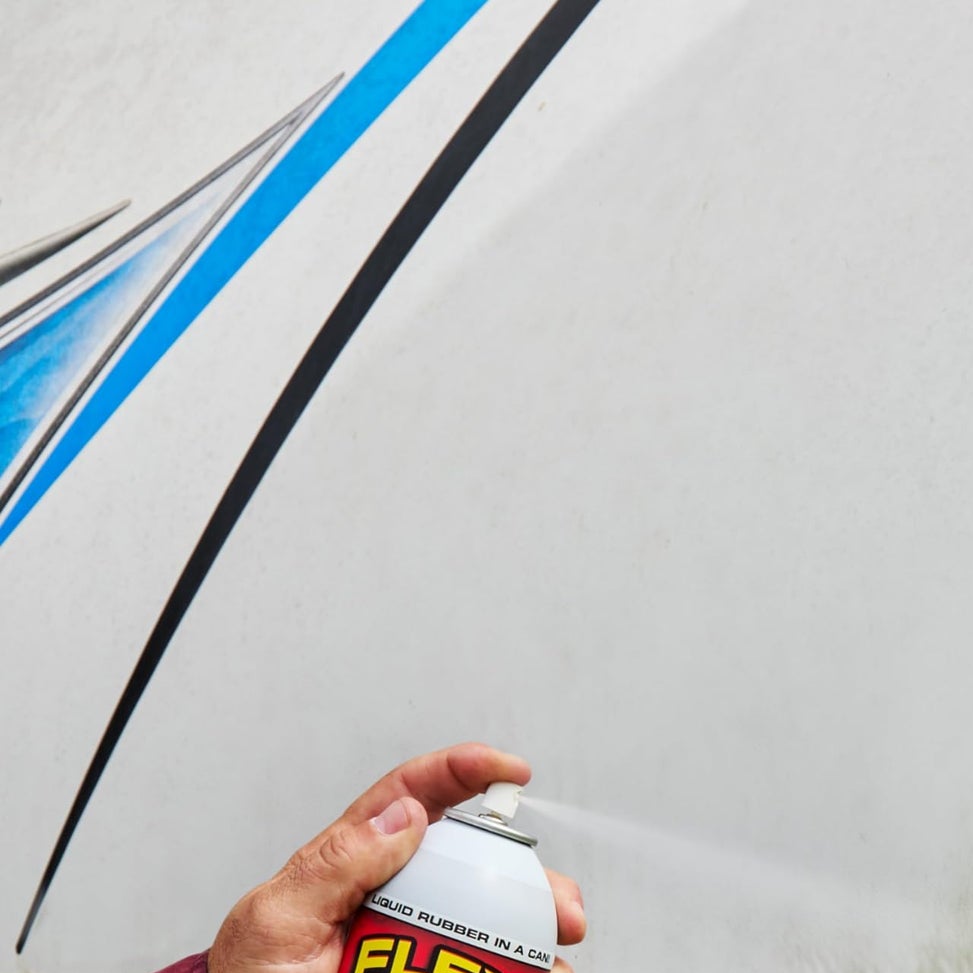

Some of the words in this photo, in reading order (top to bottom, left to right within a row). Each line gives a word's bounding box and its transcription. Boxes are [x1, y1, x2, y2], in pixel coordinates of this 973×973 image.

[371, 894, 413, 916] LIQUID
[417, 911, 490, 943] RUBBER
[494, 937, 511, 950] IN
[514, 945, 524, 955] A
